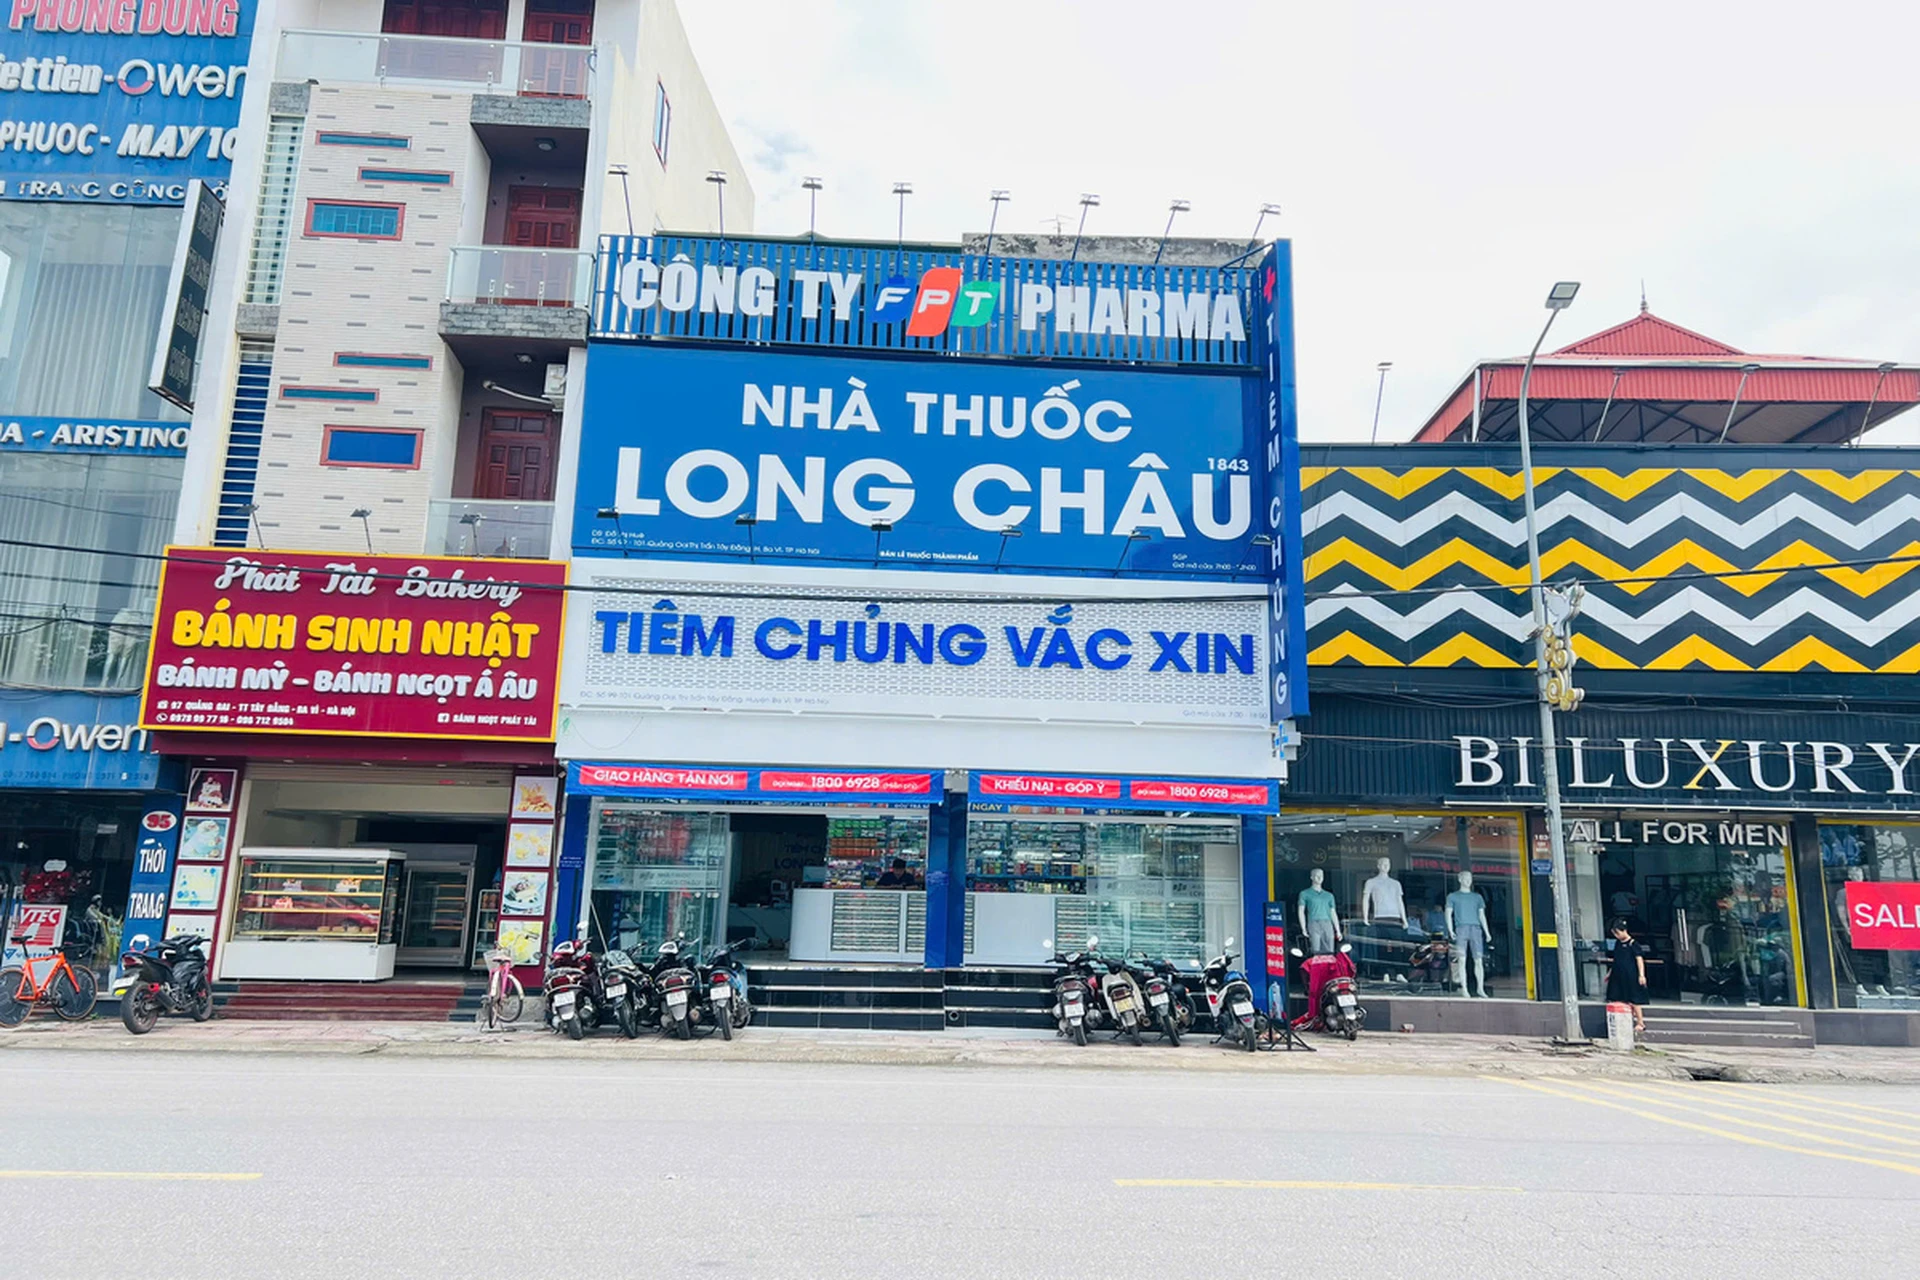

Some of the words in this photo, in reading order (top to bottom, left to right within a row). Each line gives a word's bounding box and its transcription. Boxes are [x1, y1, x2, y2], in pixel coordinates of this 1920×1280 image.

[116, 124, 206, 158] MAY
[17, 181, 100, 198] TRANG
[109, 179, 185, 200] CÔNG
[620, 255, 776, 316] CÔNG
[795, 270, 862, 321] TY
[875, 287, 993, 316] FPT
[1020, 284, 1246, 342] PHARMA
[741, 375, 880, 433] NHÀ
[906, 378, 1133, 443] THUỐC
[51, 424, 191, 448] ARISTINO
[1207, 457, 1250, 473] 1843
[615, 446, 915, 528] LONG
[952, 452, 1252, 540] CHÂU
[395, 566, 523, 607] Bakery
[172, 598, 298, 651] BÁNH
[306, 615, 412, 655] SINH
[421, 611, 540, 669] NHẬT
[595, 600, 735, 659] TIÊM
[754, 604, 988, 667] CHỦNG
[1004, 604, 1134, 671] VẮC
[1148, 631, 1256, 676] XIN
[157, 657, 238, 690] BÁNH
[313, 662, 392, 695] BÁNH
[396, 673, 473, 704] NGỌT
[473, 669, 494, 698] Á
[498, 671, 538, 700] ÂU
[205, 715, 218, 723] 77
[26, 716, 148, 752] Owen
[594, 770, 630, 783] GIAO
[633, 768, 674, 784] HÀNG
[677, 770, 708, 787] TẬN
[1453, 735, 1920, 795] BILUXURY
[811, 776, 843, 788] 1800
[845, 777, 880, 789] 6928
[994, 777, 1030, 792] KHIẾU
[1032, 781, 1054, 796] NẠI
[1065, 780, 1092, 794] GÓP
[1170, 786, 1197, 798] 1800
[1199, 787, 1229, 799] 6928
[147, 814, 171, 829] 95
[1569, 820, 1640, 844] ALL
[1642, 822, 1708, 846] FOR
[1711, 823, 1789, 847] MEN
[139, 843, 167, 873] THỜI
[20, 909, 60, 924] VTEC
[129, 892, 166, 919] TRANG
